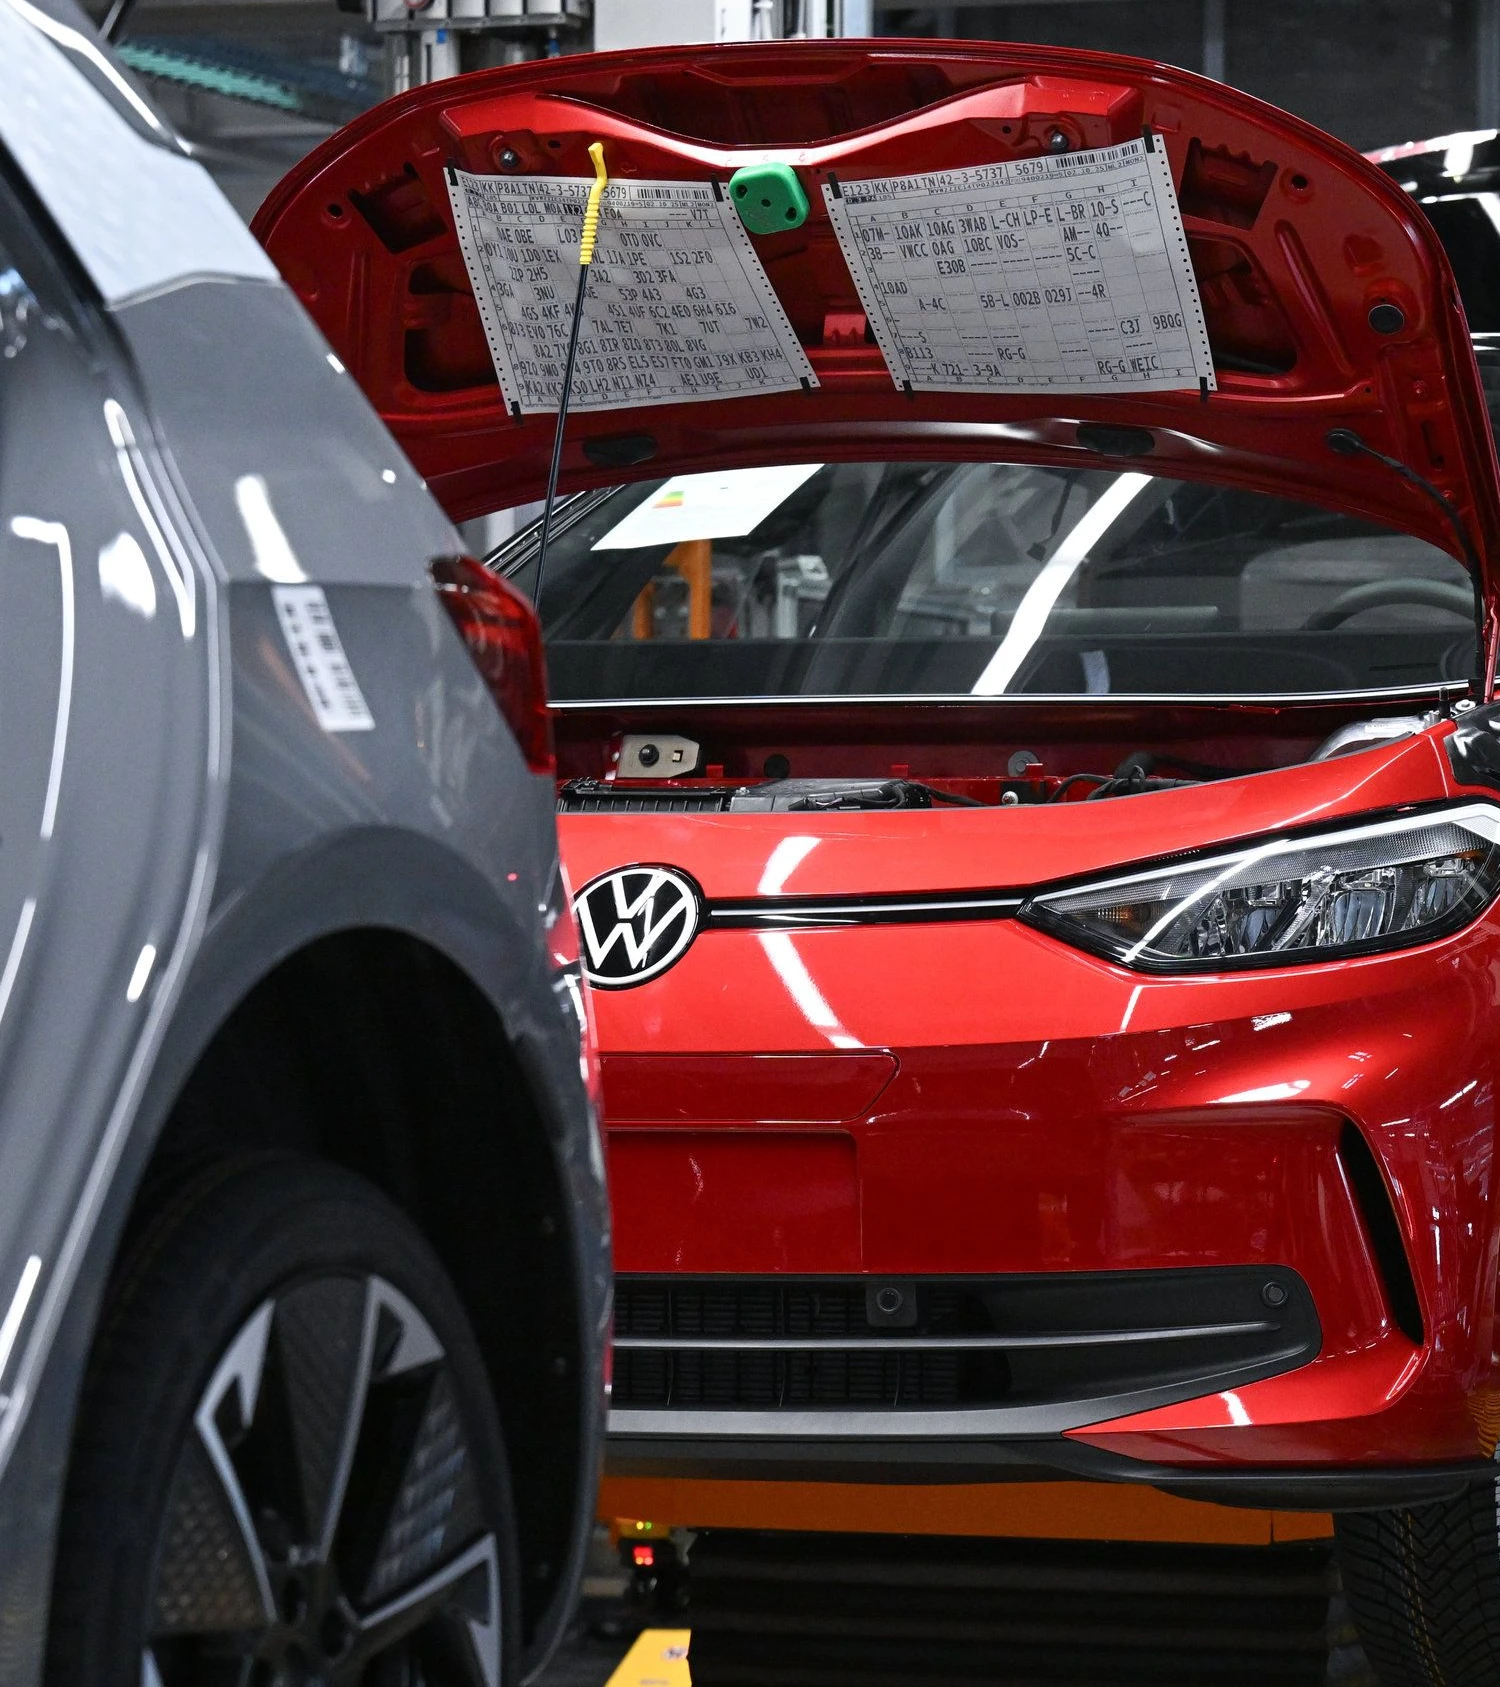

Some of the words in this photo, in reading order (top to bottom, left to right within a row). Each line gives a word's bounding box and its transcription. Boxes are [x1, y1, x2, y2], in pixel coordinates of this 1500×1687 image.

[842, 183, 870, 197] E123
[874, 181, 890, 193] KK
[892, 176, 937, 192] P8A1TN
[941, 166, 1003, 185] 42-3-5737
[1015, 161, 1043, 176] 5679
[481, 182, 496, 193] KK
[603, 185, 627, 198] 5679
[502, 202, 520, 215] B01
[603, 209, 623, 220] F0A
[690, 209, 710, 220] V7T
[895, 223, 923, 240] 10AK
[927, 220, 955, 237] 10AG
[961, 216, 987, 233] 3WAB
[990, 210, 1021, 229] L-CH
[1022, 207, 1053, 226] LP-E
[1056, 204, 1087, 221] L-BR
[1091, 199, 1119, 218] 10-S
[557, 228, 577, 244] L03
[591, 250, 605, 264] NL
[627, 252, 647, 266] 1PE
[670, 252, 691, 265] 1S2
[900, 243, 928, 258] VWCC
[1066, 245, 1096, 261] 5C-C
[526, 266, 548, 281] 2H5
[590, 269, 611, 283] 3A2
[655, 269, 677, 284] 3FA
[534, 285, 555, 300] 3NU
[642, 288, 662, 301] 4A3
[686, 286, 706, 300] 4G3
[919, 298, 946, 311] A-4C
[980, 293, 1009, 309] 5B-L
[542, 304, 561, 319] 4KF
[628, 305, 646, 318] 4UF
[649, 305, 670, 319] 6C2
[693, 303, 713, 317] 6H4
[592, 320, 613, 334] 7AL
[614, 320, 633, 333] 7E7
[656, 322, 677, 335] 7K1
[700, 321, 720, 334] 7UT
[744, 316, 768, 330] 7W2
[1120, 318, 1141, 335] C3J
[1153, 313, 1183, 330] 9BQG
[560, 362, 581, 375] 94
[606, 357, 627, 371] 8RS
[628, 355, 649, 369] EL5
[650, 355, 670, 369] ES7
[737, 351, 760, 364] KB3
[760, 348, 783, 362] KH4
[997, 347, 1026, 361] RG-G
[973, 364, 1001, 377] 3-9A
[1098, 359, 1126, 376] RG-G
[589, 378, 611, 392] LH2
[635, 373, 656, 389] NZ4
[701, 372, 722, 385] U9E
[745, 366, 768, 379] UD1
